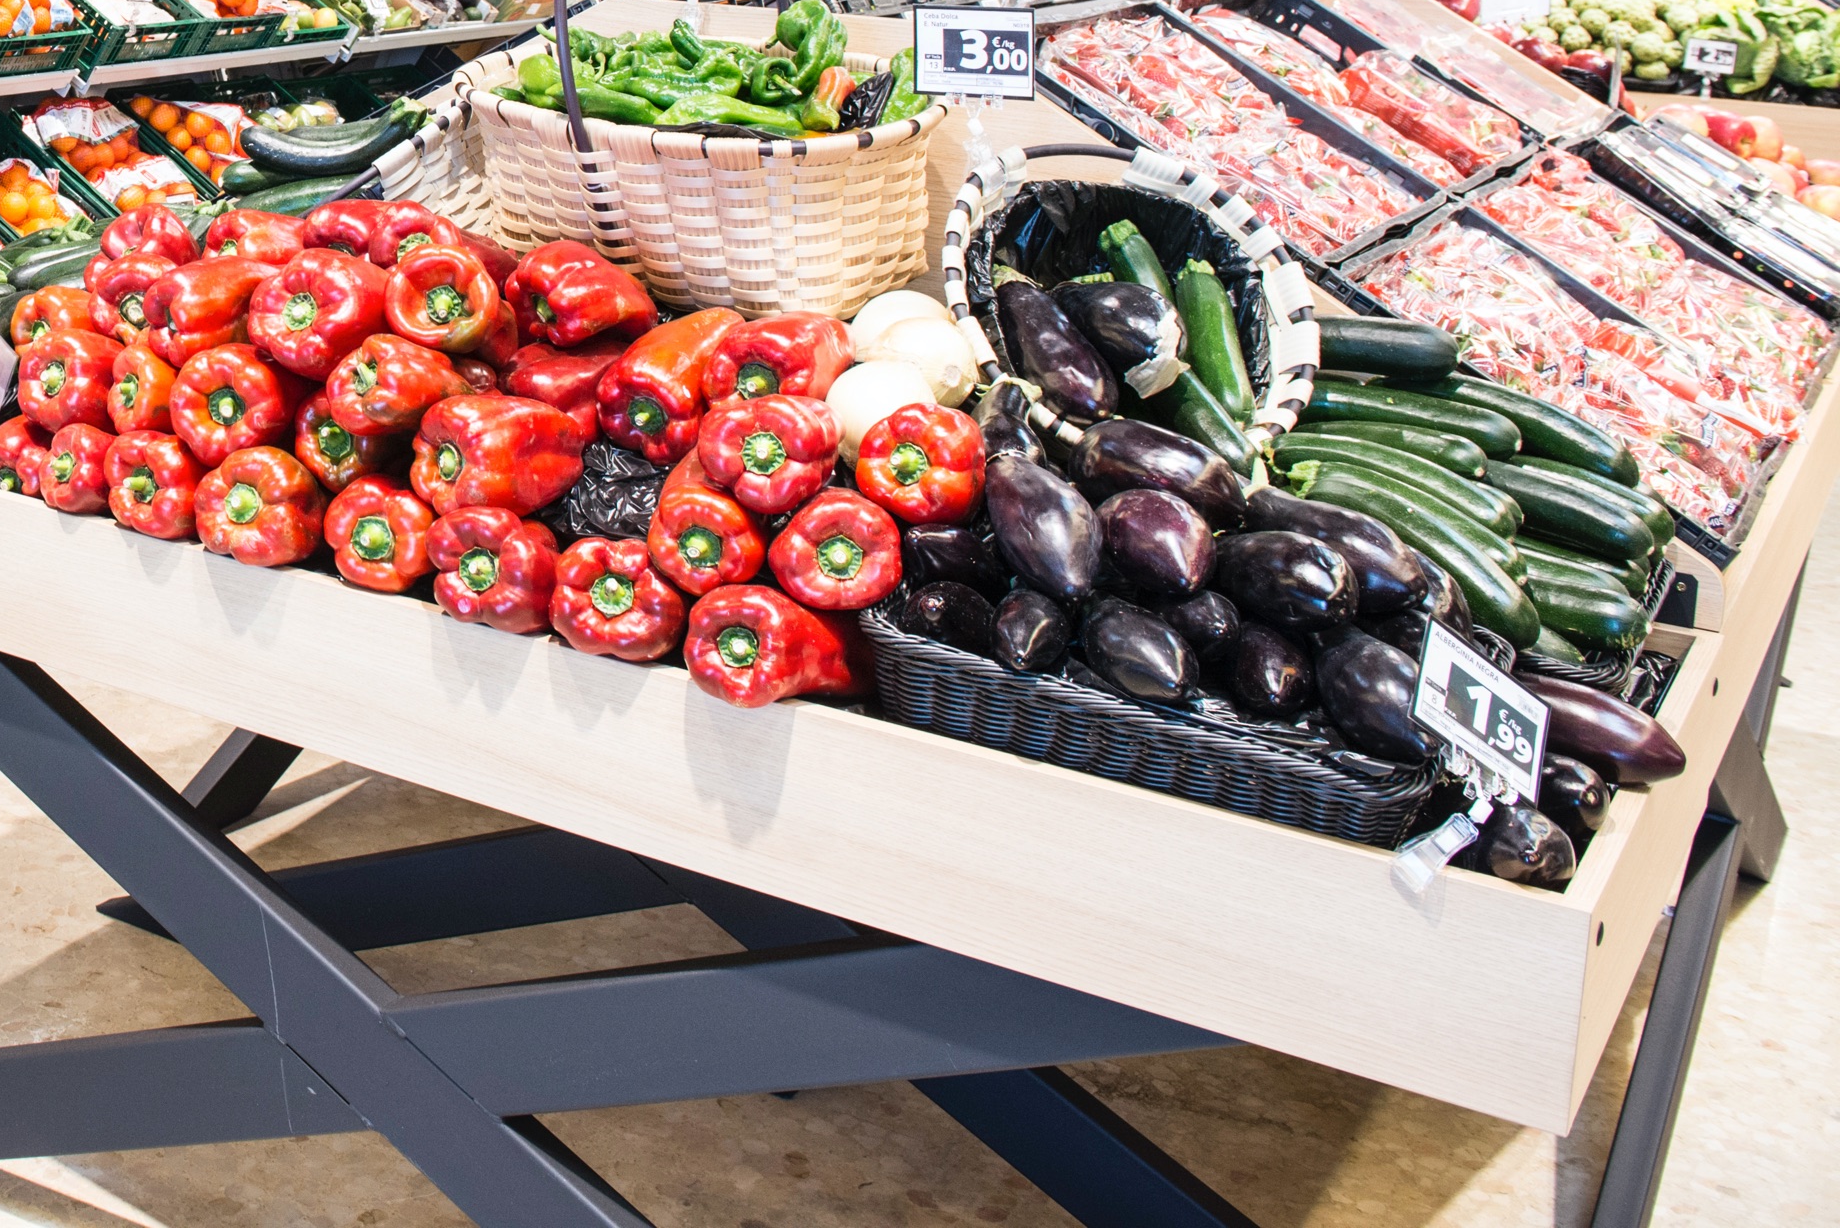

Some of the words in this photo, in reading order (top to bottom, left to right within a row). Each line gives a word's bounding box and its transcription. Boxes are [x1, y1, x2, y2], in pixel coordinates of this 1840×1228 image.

[924, 12, 938, 20] Ceba
[929, 61, 939, 70] 13
[959, 29, 1028, 74] 3,00
[1435, 631, 1475, 663] ALBERGINIA
[1476, 659, 1499, 683] NEGRA
[1466, 685, 1533, 764] 1,99
